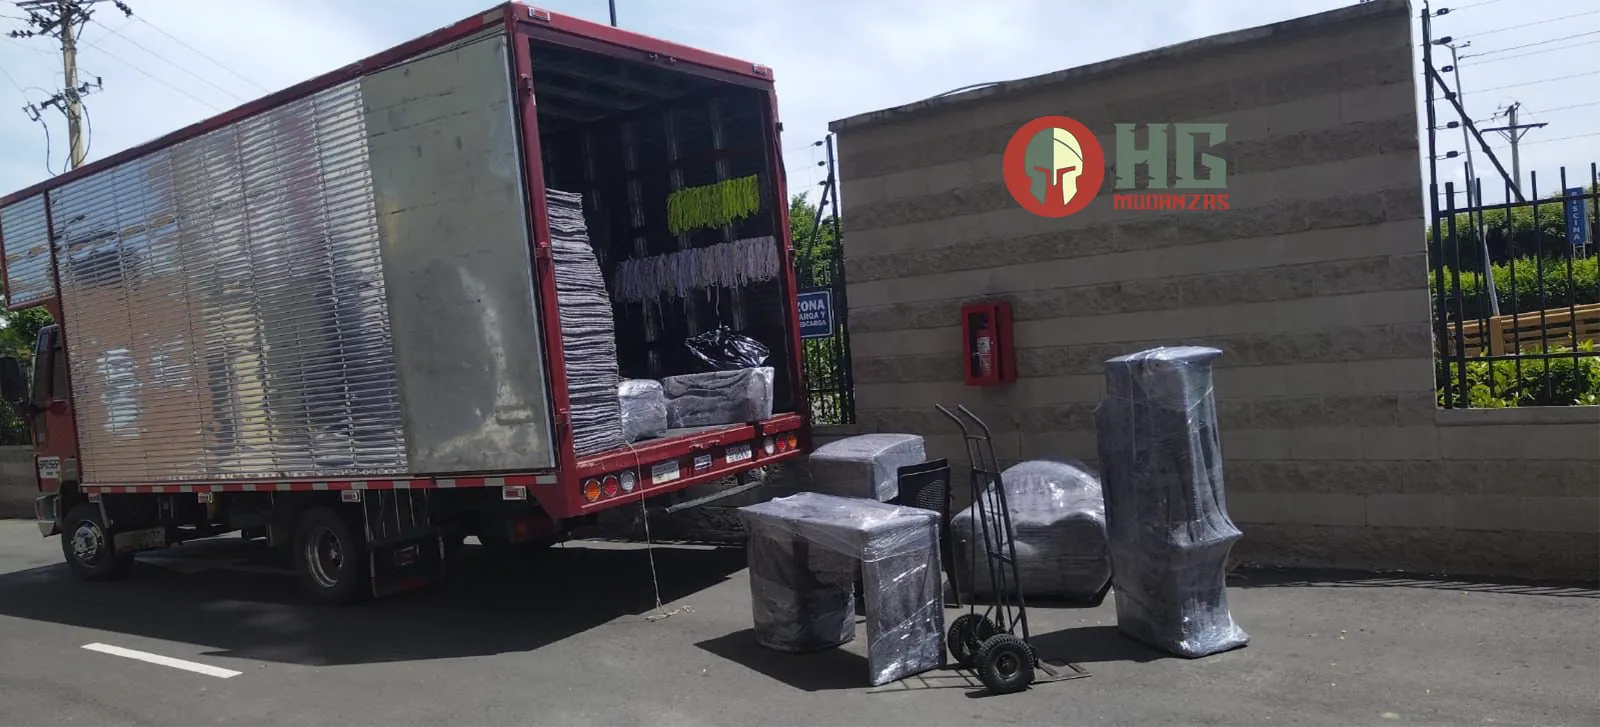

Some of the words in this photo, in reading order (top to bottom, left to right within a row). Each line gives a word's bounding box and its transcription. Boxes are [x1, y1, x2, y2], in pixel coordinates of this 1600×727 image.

[1571, 191, 1581, 241] PISCINA
[799, 312, 819, 321] ARGA
[820, 311, 826, 319] Y
[799, 319, 827, 328] ESCARGA
